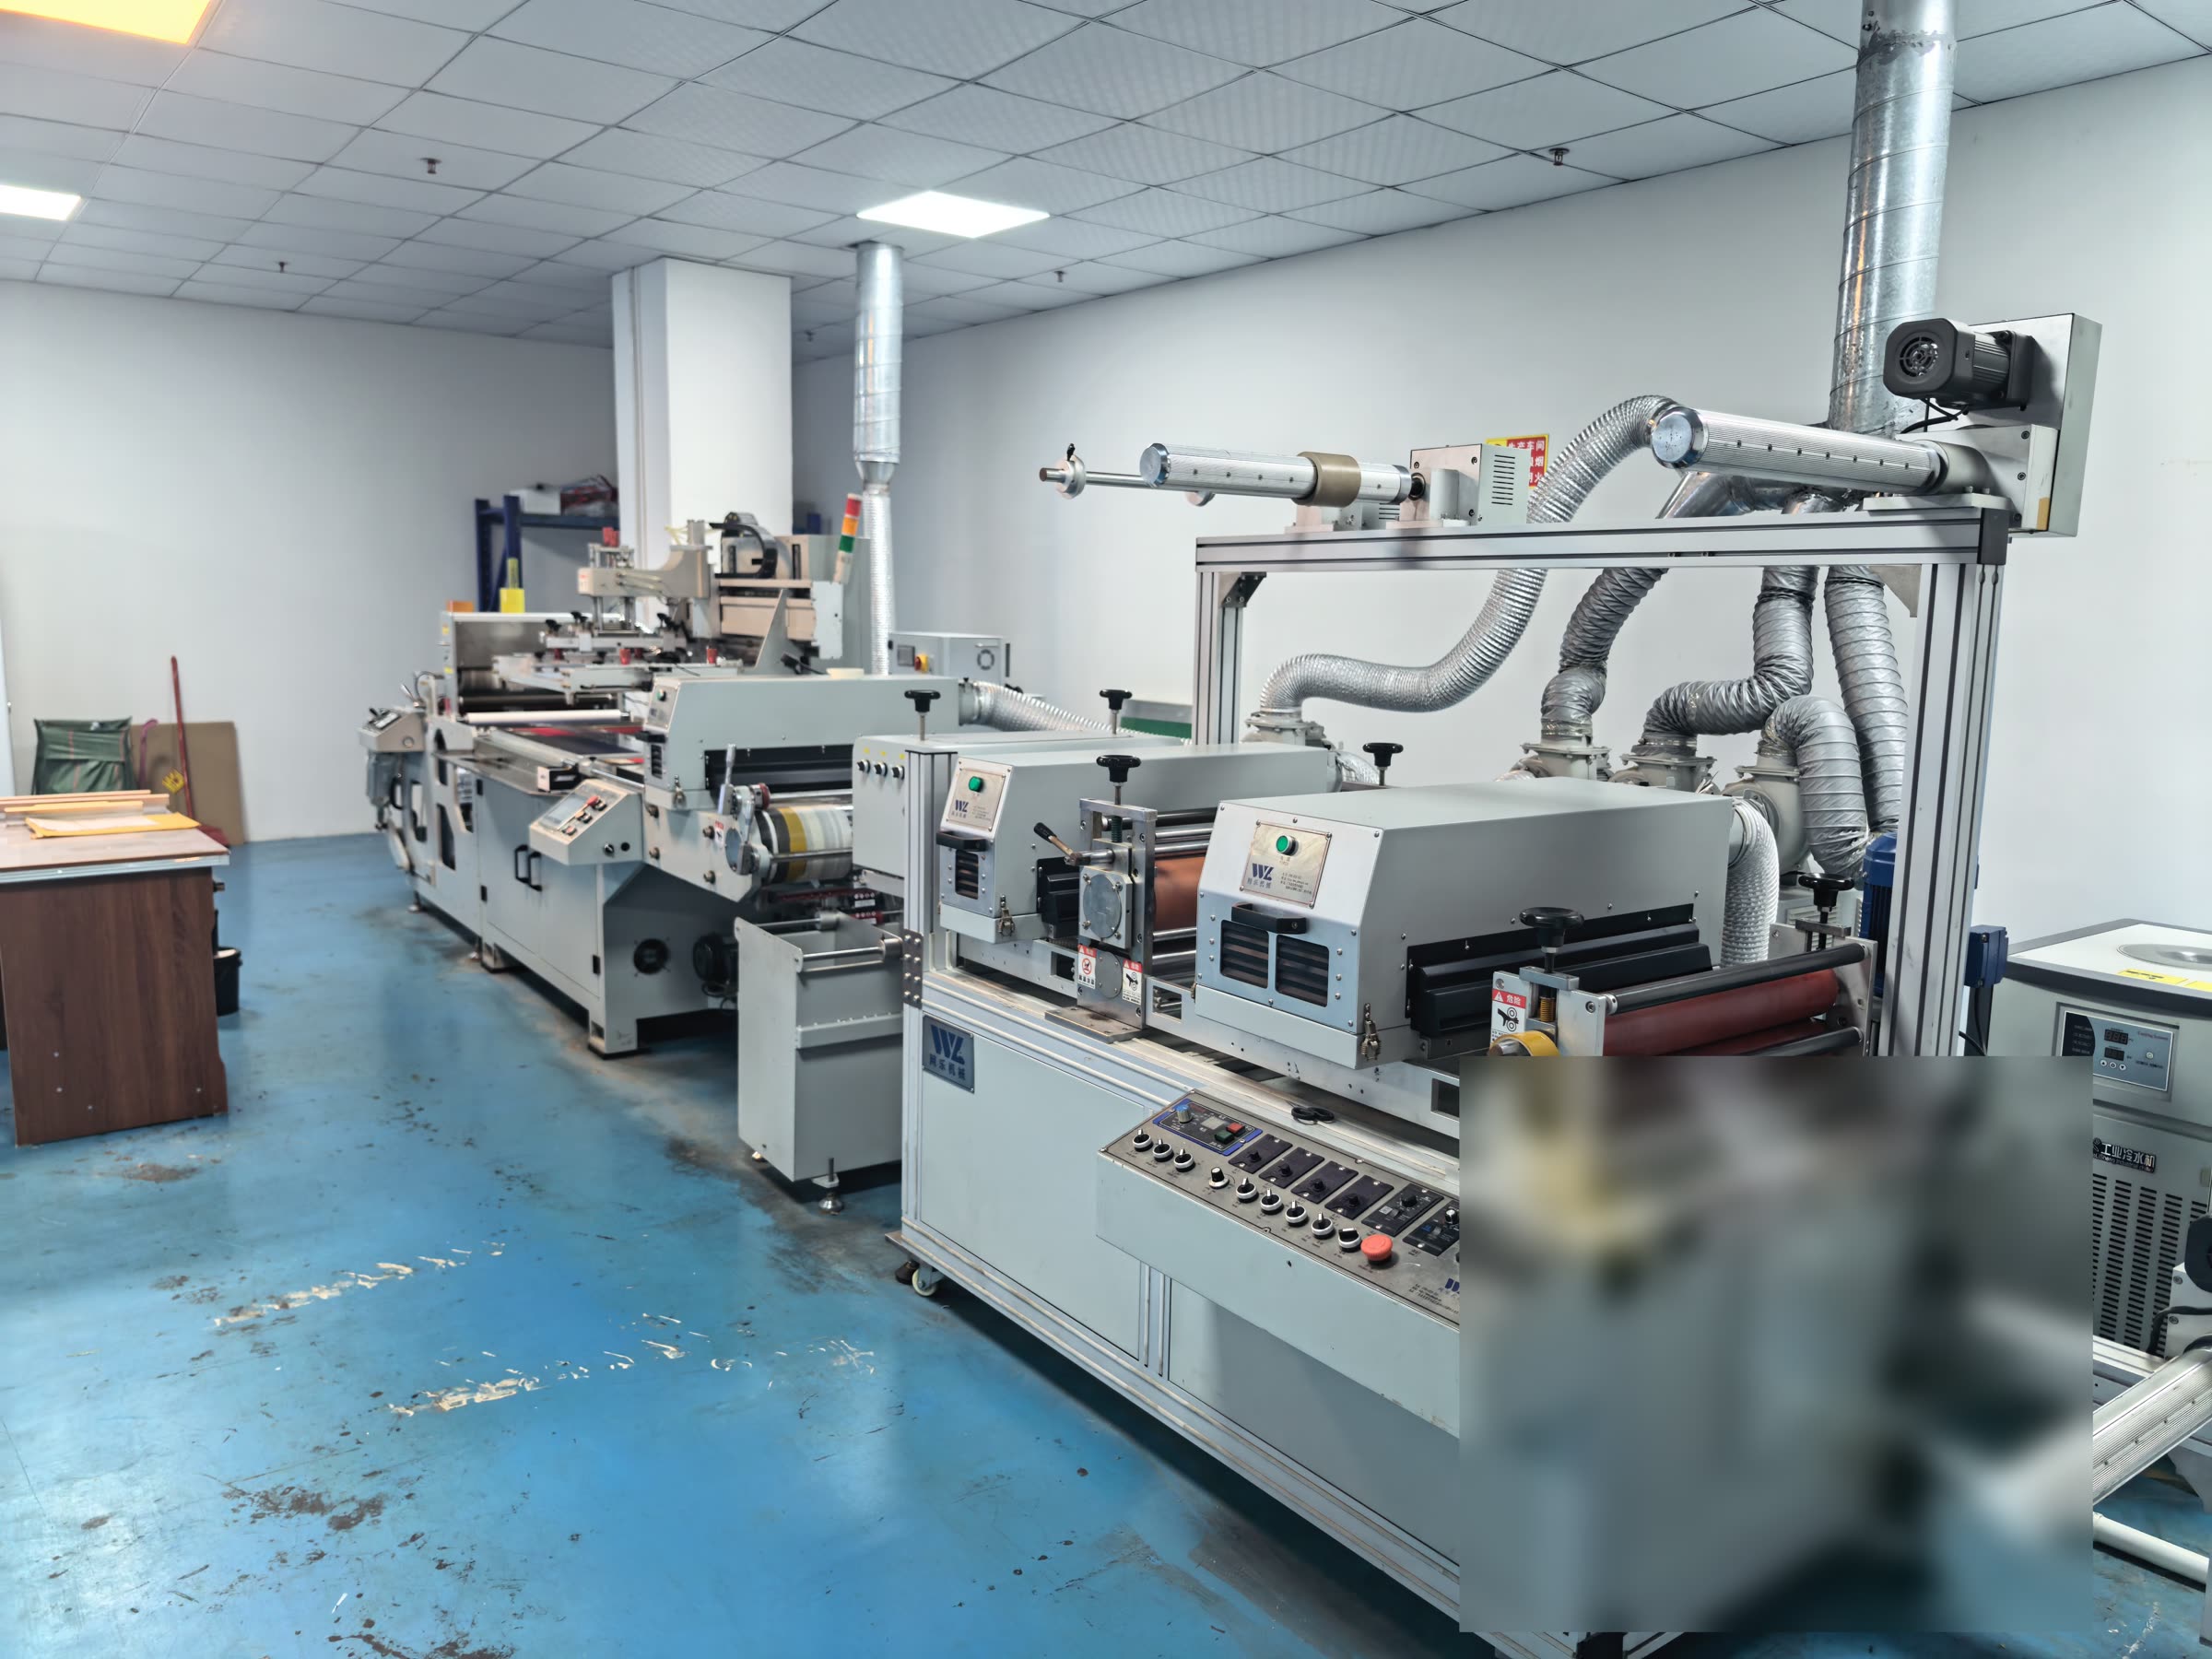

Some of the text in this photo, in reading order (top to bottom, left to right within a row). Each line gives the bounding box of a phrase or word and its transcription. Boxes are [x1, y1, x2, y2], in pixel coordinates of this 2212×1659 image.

[1531, 455, 1545, 467] 烟
[1506, 994, 1521, 1006] 危险
[2100, 1142, 2155, 1168] 工业冷水机
